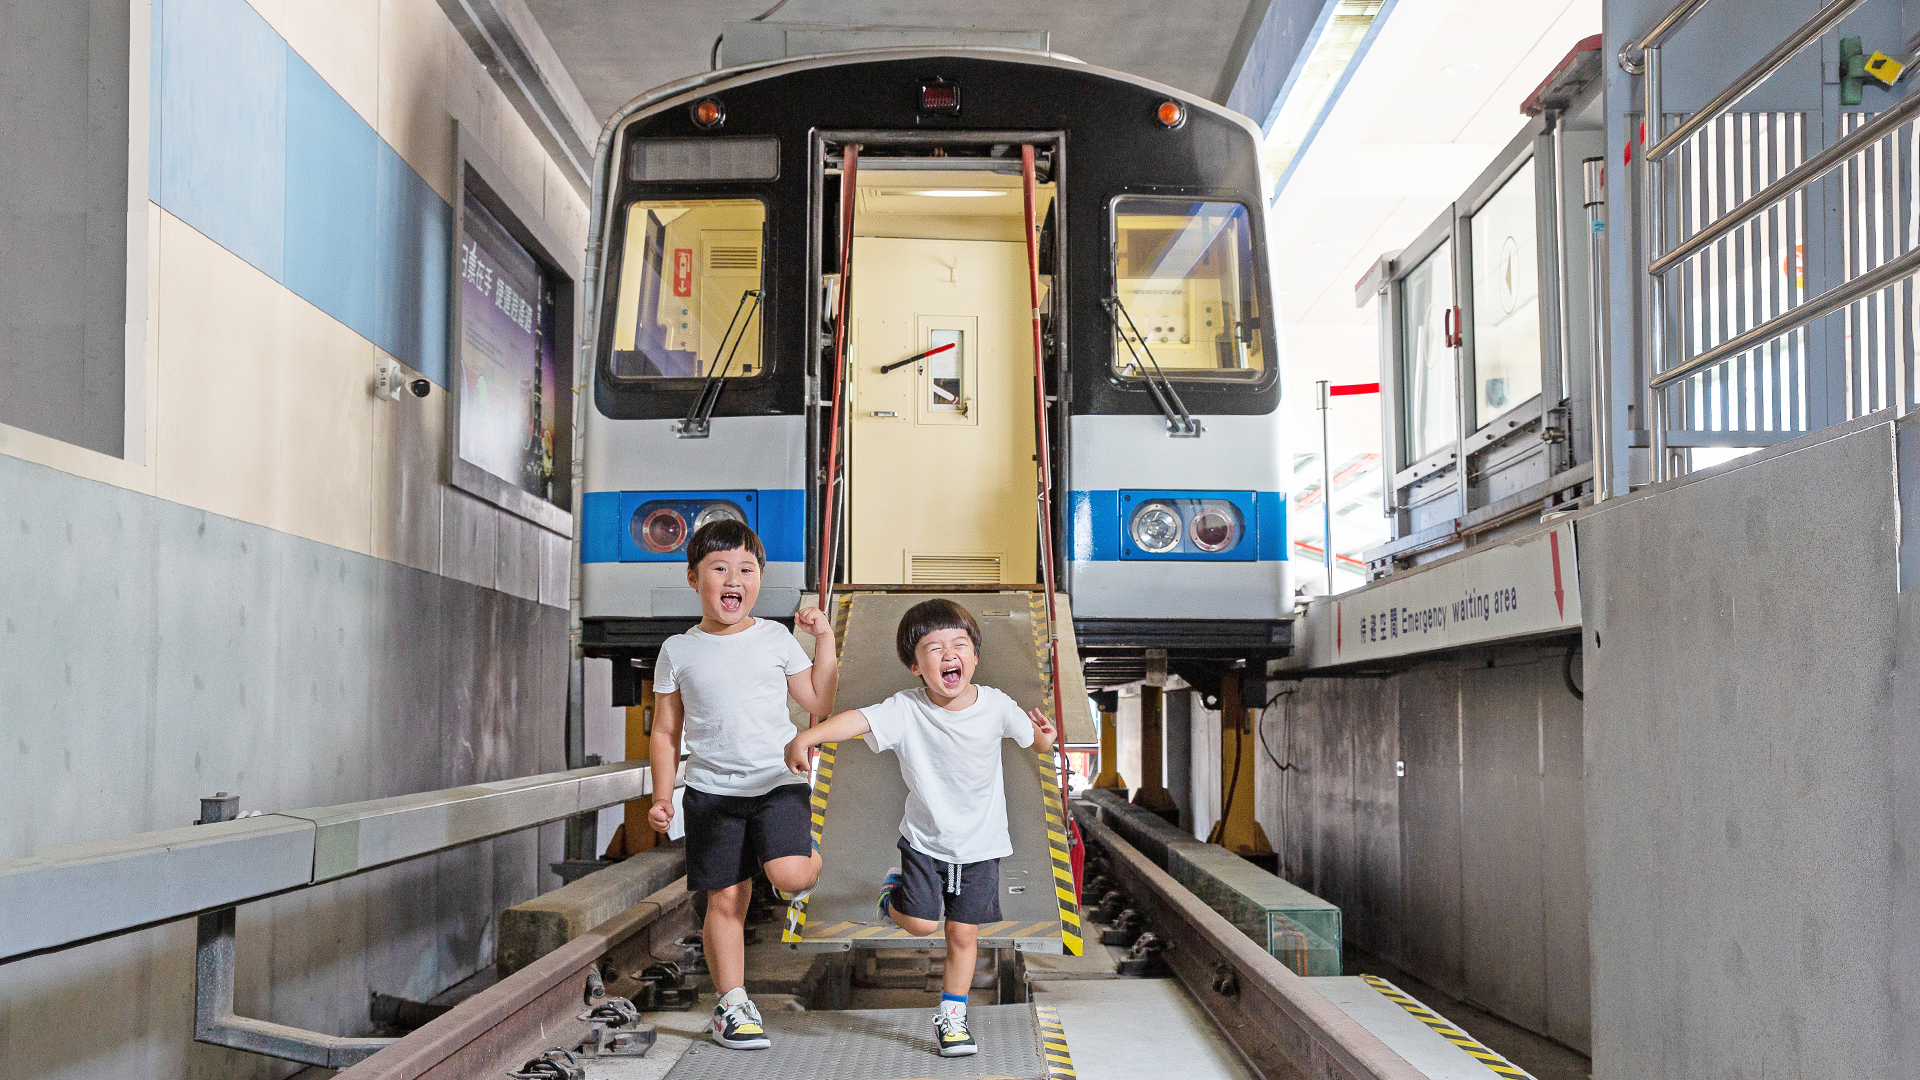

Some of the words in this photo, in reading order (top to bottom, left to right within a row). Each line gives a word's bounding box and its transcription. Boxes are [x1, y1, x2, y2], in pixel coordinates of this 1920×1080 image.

[1360, 607, 1398, 645] 待避空間
[1402, 605, 1447, 634] Emergency
[1452, 587, 1490, 622] waiting
[1494, 586, 1518, 613] area
